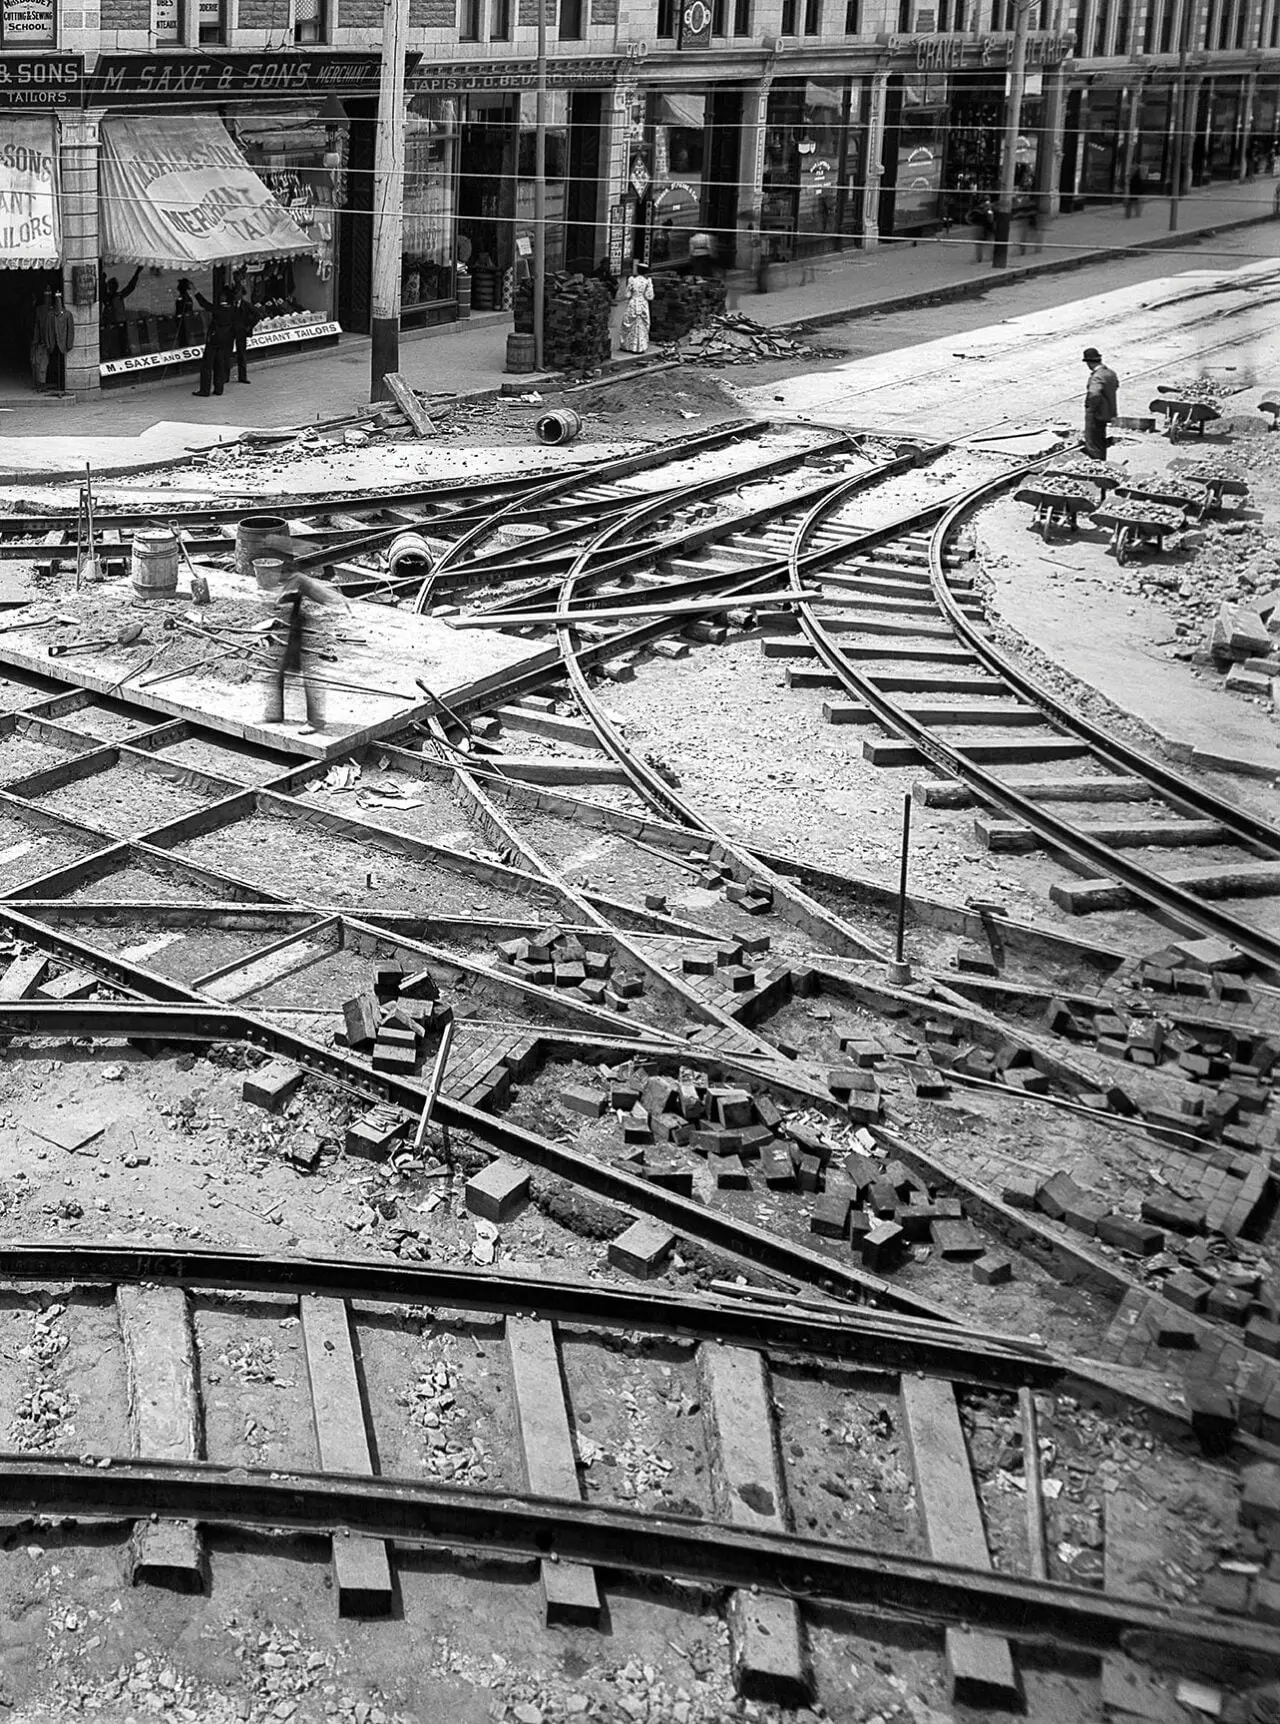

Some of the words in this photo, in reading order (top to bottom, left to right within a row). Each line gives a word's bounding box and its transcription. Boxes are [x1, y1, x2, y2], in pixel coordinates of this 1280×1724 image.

[8, 23, 51, 31] SCHOOL.
[18, 64, 78, 84] SONS
[136, 65, 211, 92] SAXE
[216, 65, 234, 89] &
[243, 63, 311, 88] SONS
[316, 65, 367, 84] MERCHANT
[412, 79, 458, 91] TAPIS
[570, 71, 614, 83] CARPETS
[7, 91, 71, 103] TAILORS.
[3, 143, 52, 182] SONS
[160, 185, 254, 233] MERCHANT
[124, 354, 161, 369] SAXE
[163, 352, 182, 362] AND
[246, 332, 291, 348] ERCHANT
[294, 323, 338, 337] TAILORS
